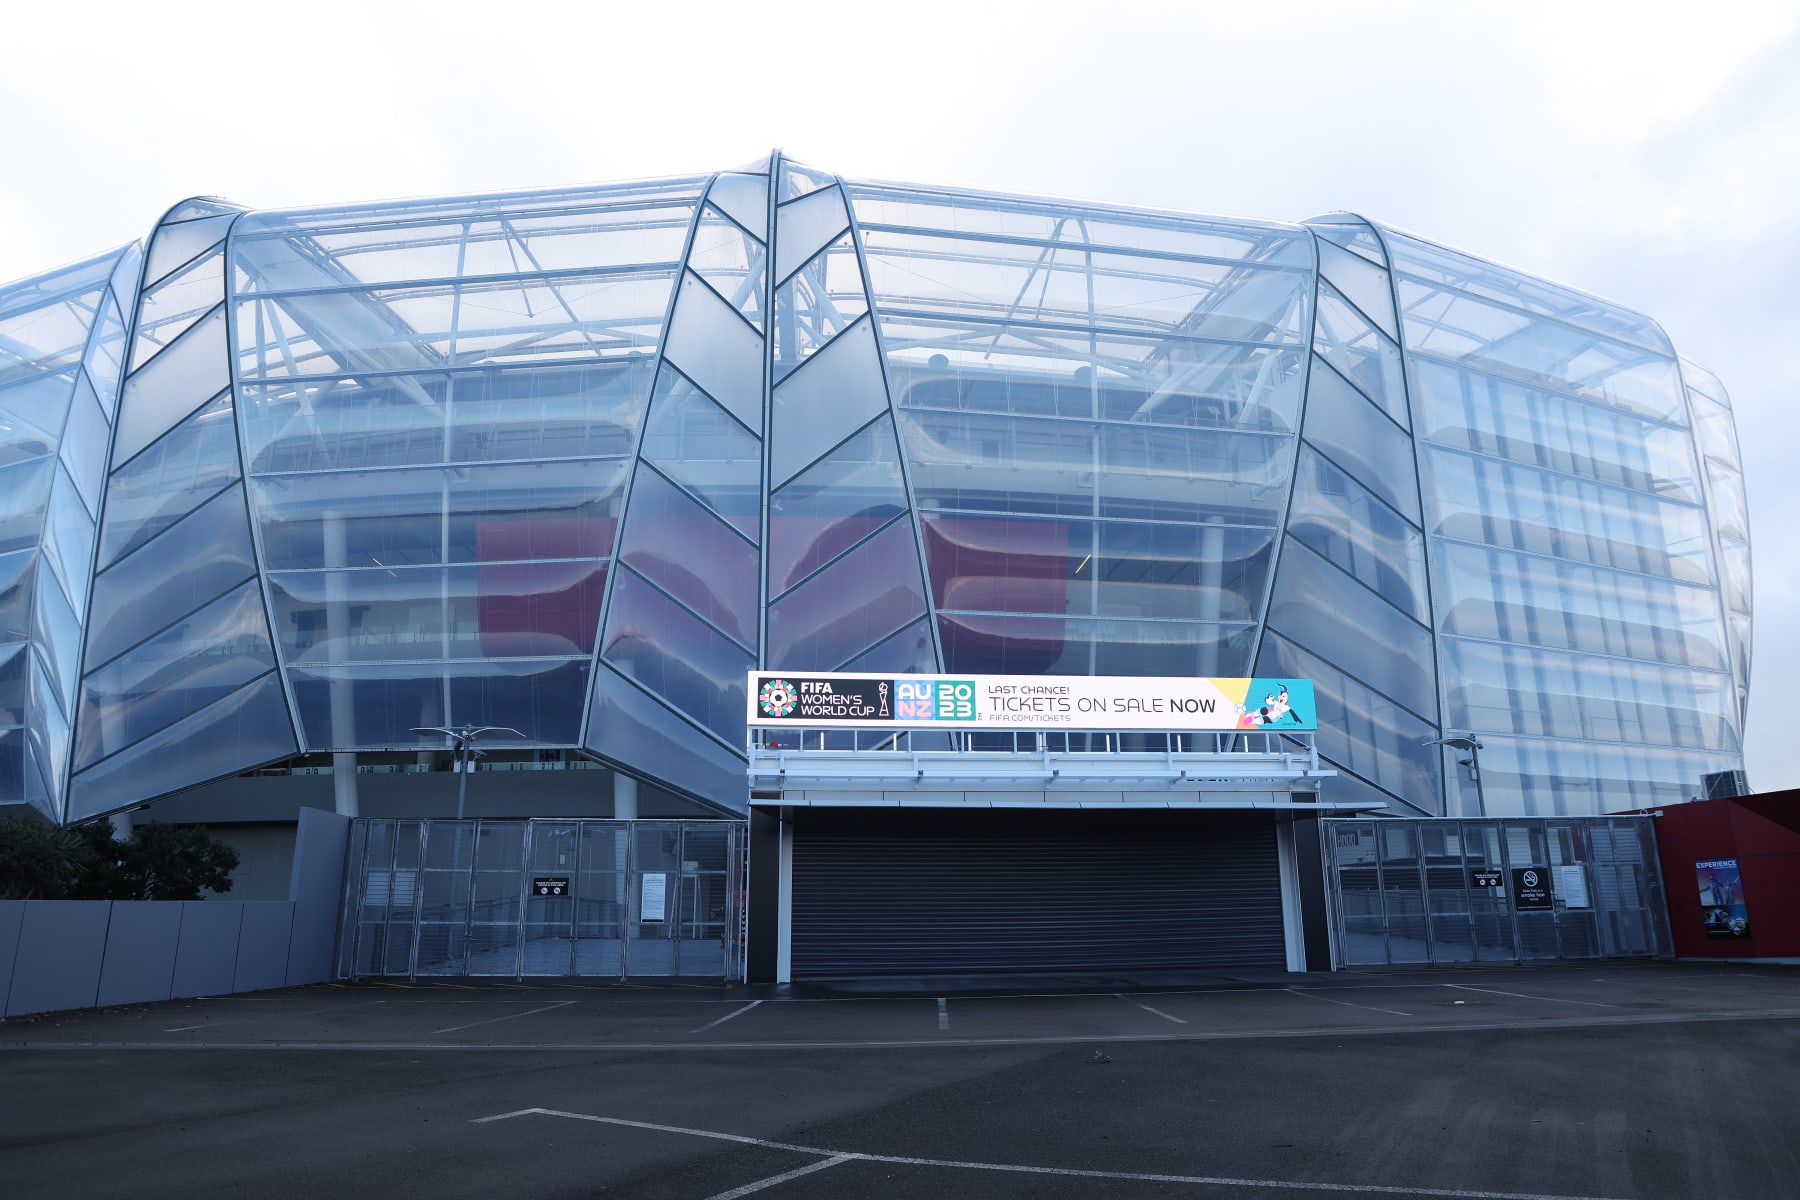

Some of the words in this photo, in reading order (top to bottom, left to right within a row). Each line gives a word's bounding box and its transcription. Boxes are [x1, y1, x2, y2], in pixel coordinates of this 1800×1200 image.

[801, 682, 833, 693] FIFA
[898, 684, 931, 700] AU
[989, 685, 1017, 693] LAST
[1020, 686, 1070, 694] CHANCE!
[801, 694, 862, 704] WOMEN'S
[801, 705, 847, 715] WORLD
[849, 706, 875, 716] CUP
[898, 701, 932, 717] NZ
[989, 697, 1071, 711] TICKETS
[1078, 698, 1106, 712] ON
[1113, 698, 1164, 712] SALE
[1170, 698, 1216, 713] NOW
[989, 714, 1071, 722] FIFA.COM/TICKETS
[1695, 860, 1737, 869] EXPERIENCE
